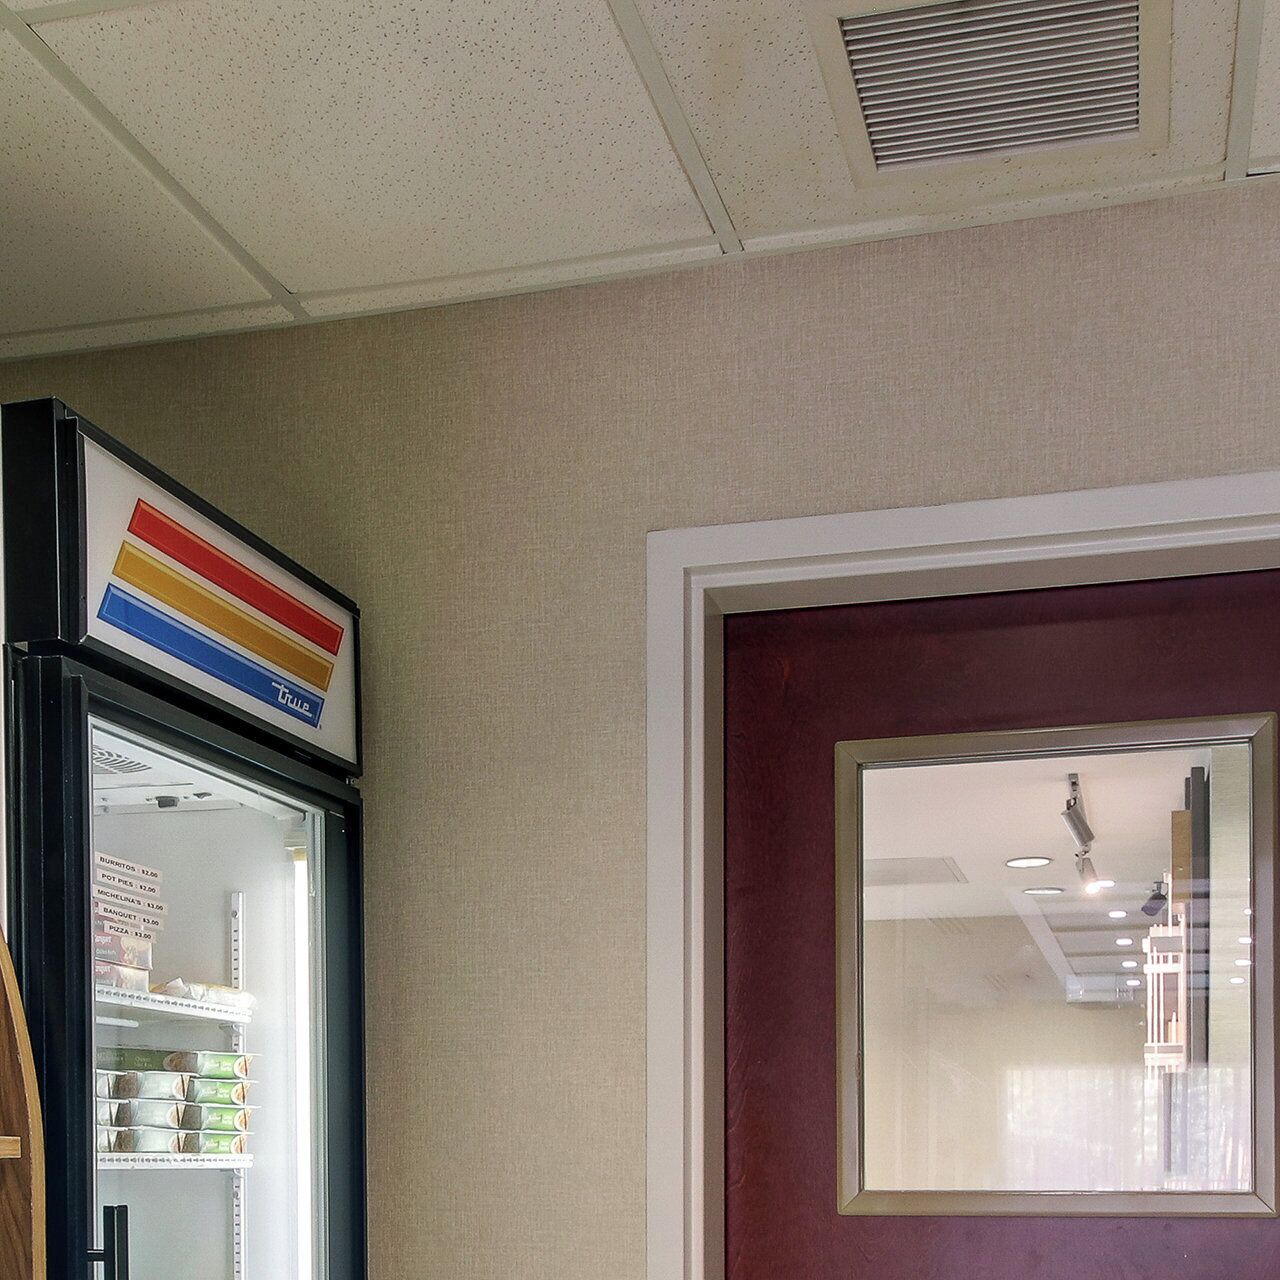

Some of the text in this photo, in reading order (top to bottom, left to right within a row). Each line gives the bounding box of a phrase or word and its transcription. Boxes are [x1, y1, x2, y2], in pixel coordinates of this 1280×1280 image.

[100, 856, 158, 878] BURRITOS $2.00
[102, 873, 156, 894] POT PIES $2.00
[97, 888, 164, 911] MICHELINA'S $3.00
[103, 906, 159, 927] BANQUET $3.00
[109, 924, 151, 940] PIZZA $3.00
